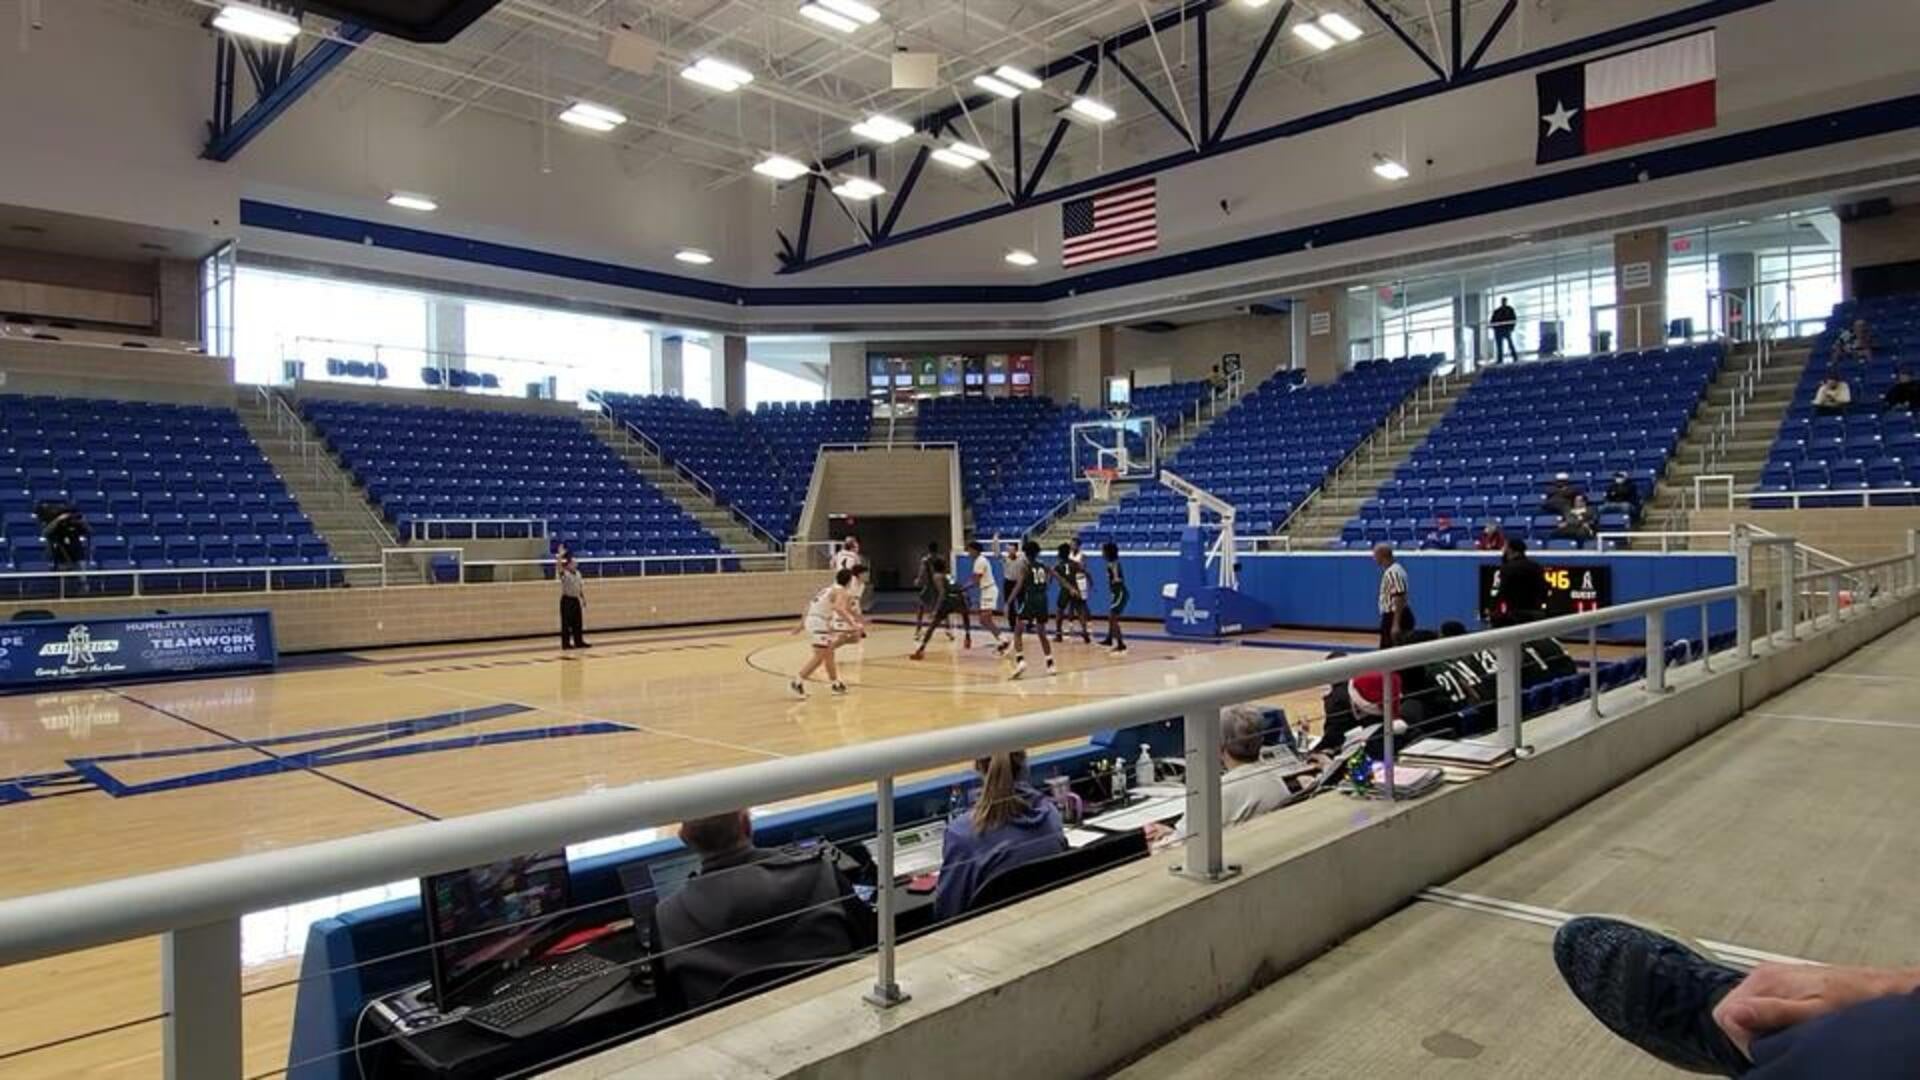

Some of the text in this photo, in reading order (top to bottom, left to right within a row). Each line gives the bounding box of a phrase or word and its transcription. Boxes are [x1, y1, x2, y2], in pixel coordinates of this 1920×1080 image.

[1544, 570, 1570, 589] 46
[126, 621, 187, 633] HUMILITY
[150, 633, 256, 650] TEAMWORK
[222, 643, 255, 653] GRIT
